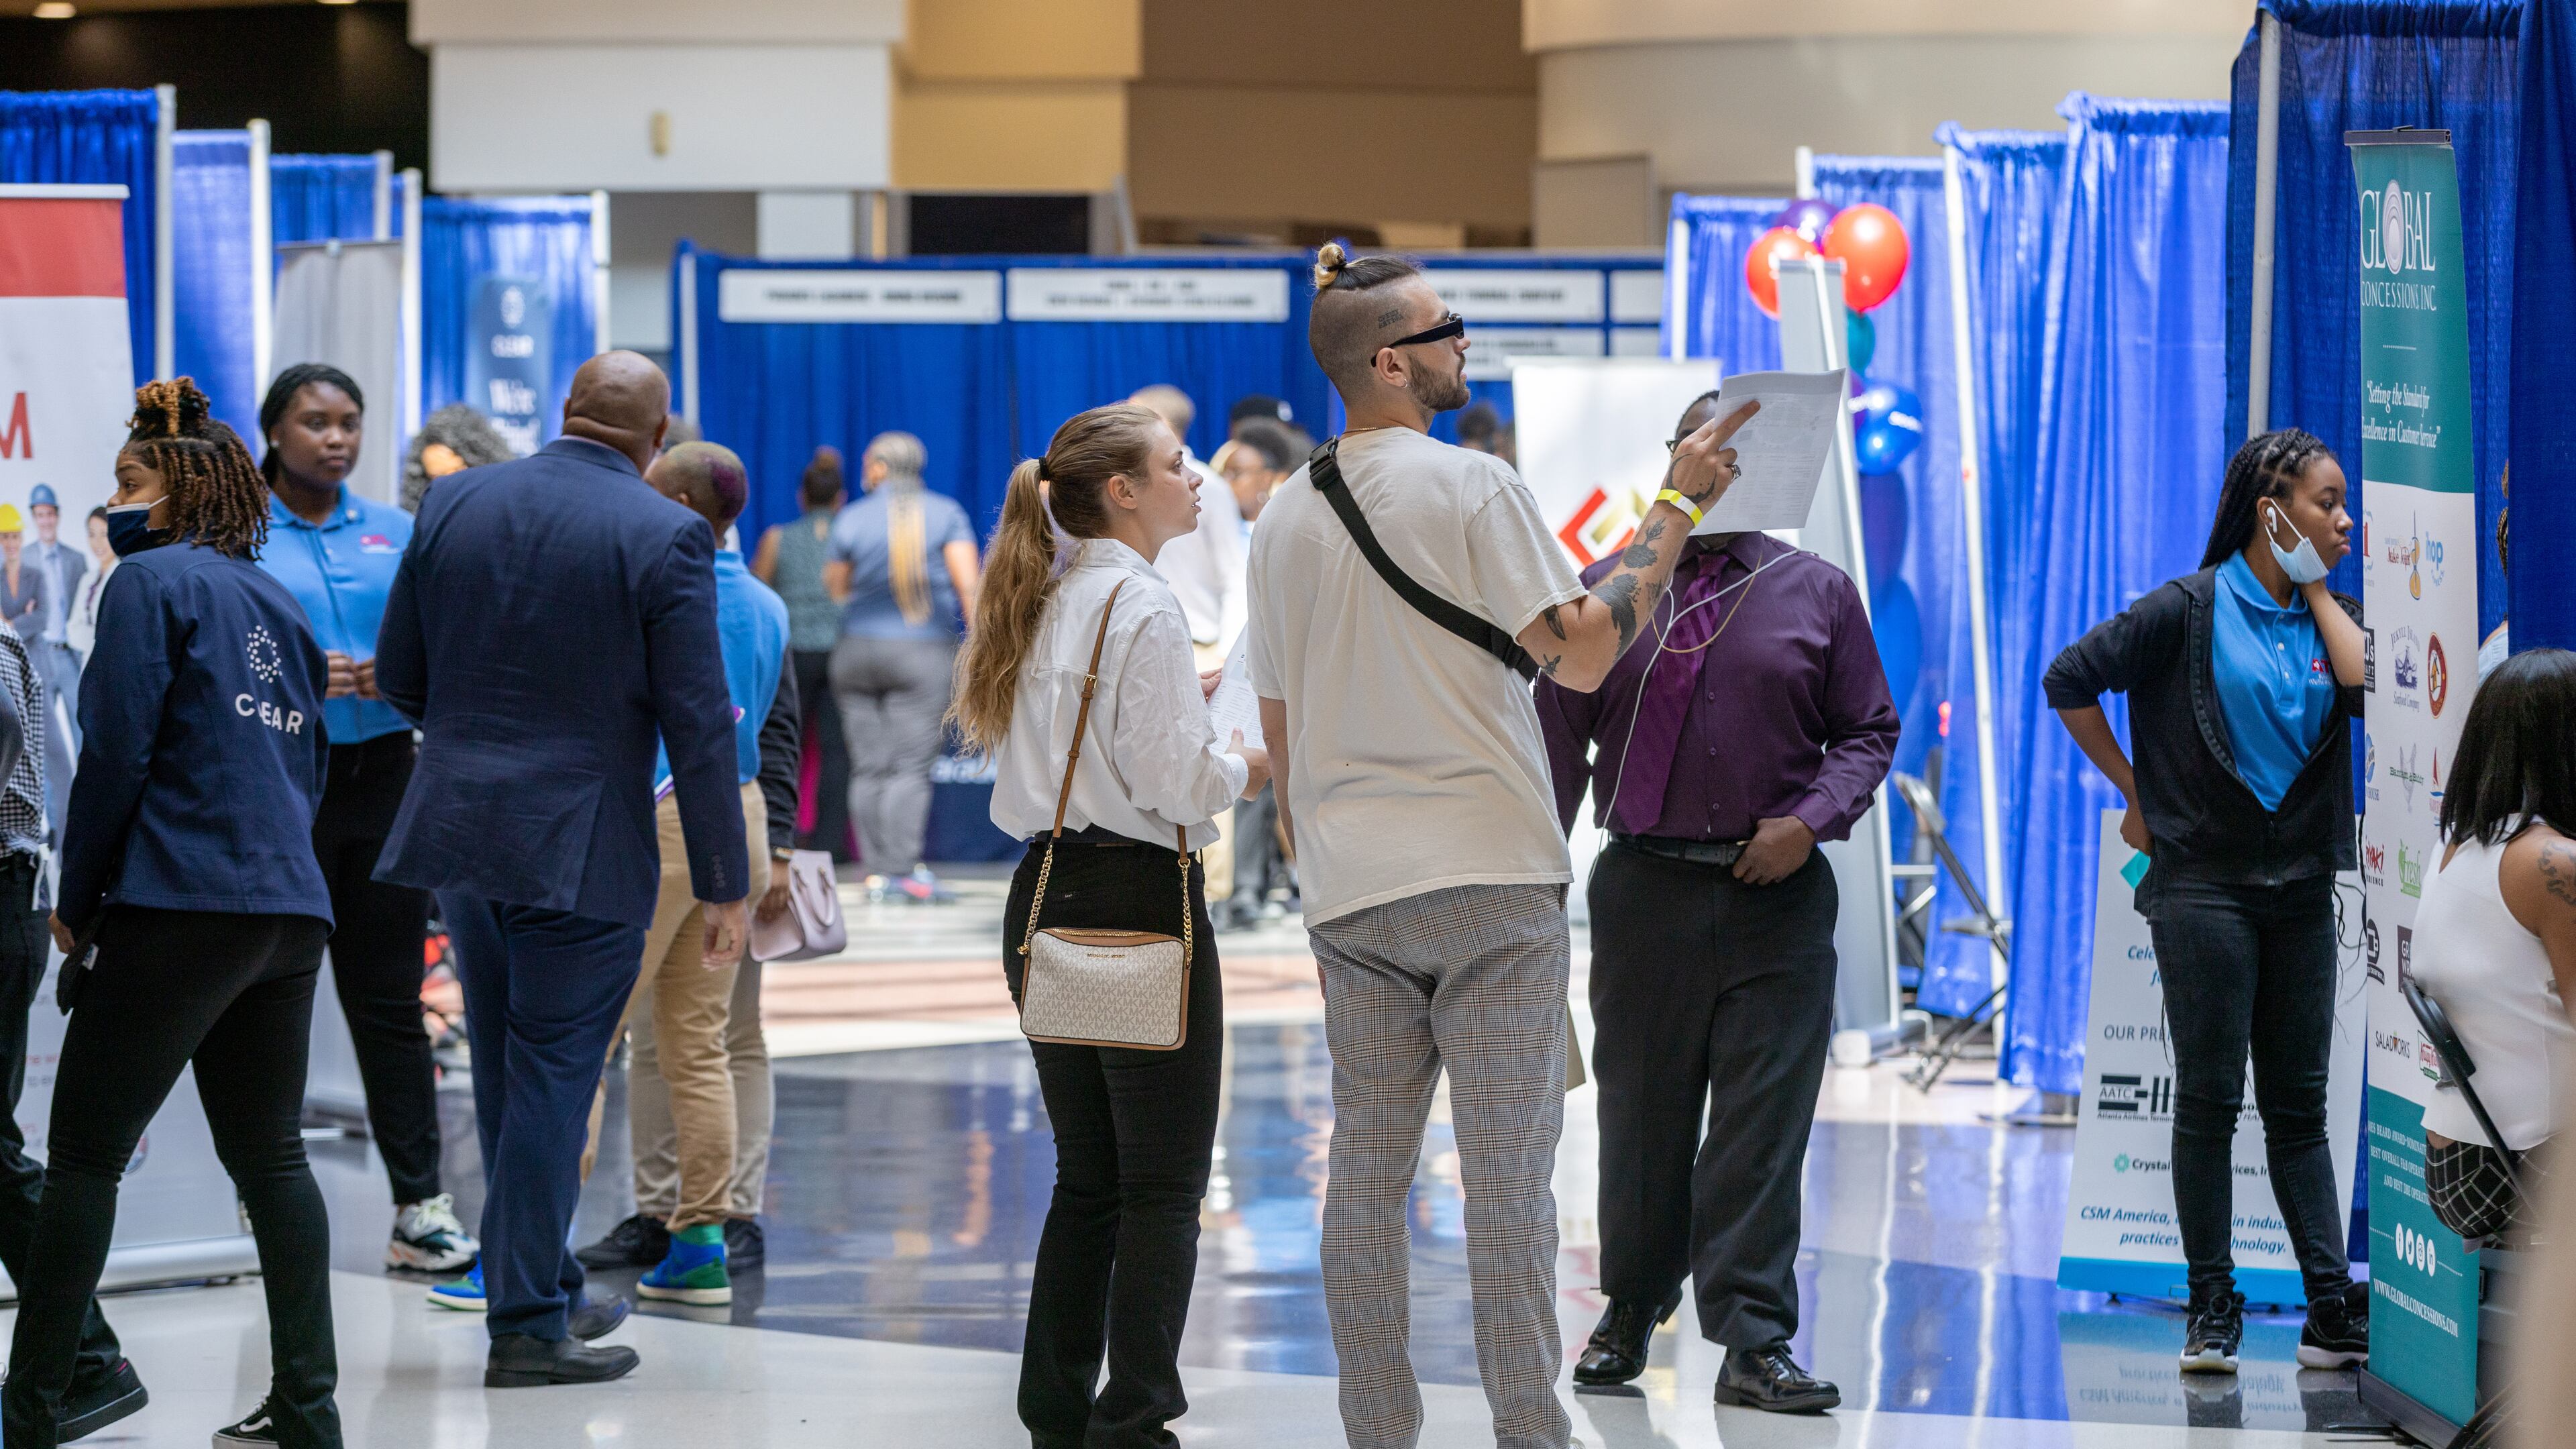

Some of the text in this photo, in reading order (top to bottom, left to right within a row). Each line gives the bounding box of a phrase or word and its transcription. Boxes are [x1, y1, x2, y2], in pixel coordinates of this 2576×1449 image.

[2361, 180, 2435, 274] GLOBAL
[2392, 382, 2402, 406] the
[2388, 420, 2396, 441] in
[2104, 1024, 2135, 1040] OUR
[2375, 1030, 2410, 1059] SALADWORKS
[2099, 1086, 2132, 1099] AATC
[2097, 1111, 2122, 1120] Atlanta
[2123, 1112, 2149, 1122] Airlines
[2377, 1124, 2392, 1140] BEARD
[2371, 1144, 2381, 1160] BEST
[2381, 1150, 2400, 1167] OVERALL
[2133, 1159, 2171, 1173] Crystal
[2383, 1173, 2394, 1188] AND
[2394, 1178, 2404, 1193] BEST
[2081, 1205, 2110, 1220] CSM
[2113, 1208, 2170, 1227] America,
[2233, 1214, 2244, 1228] in
[2119, 1230, 2179, 1246] practices
[2373, 1277, 2458, 1338] WWW.GLOBALCONCESSIONS.COM
